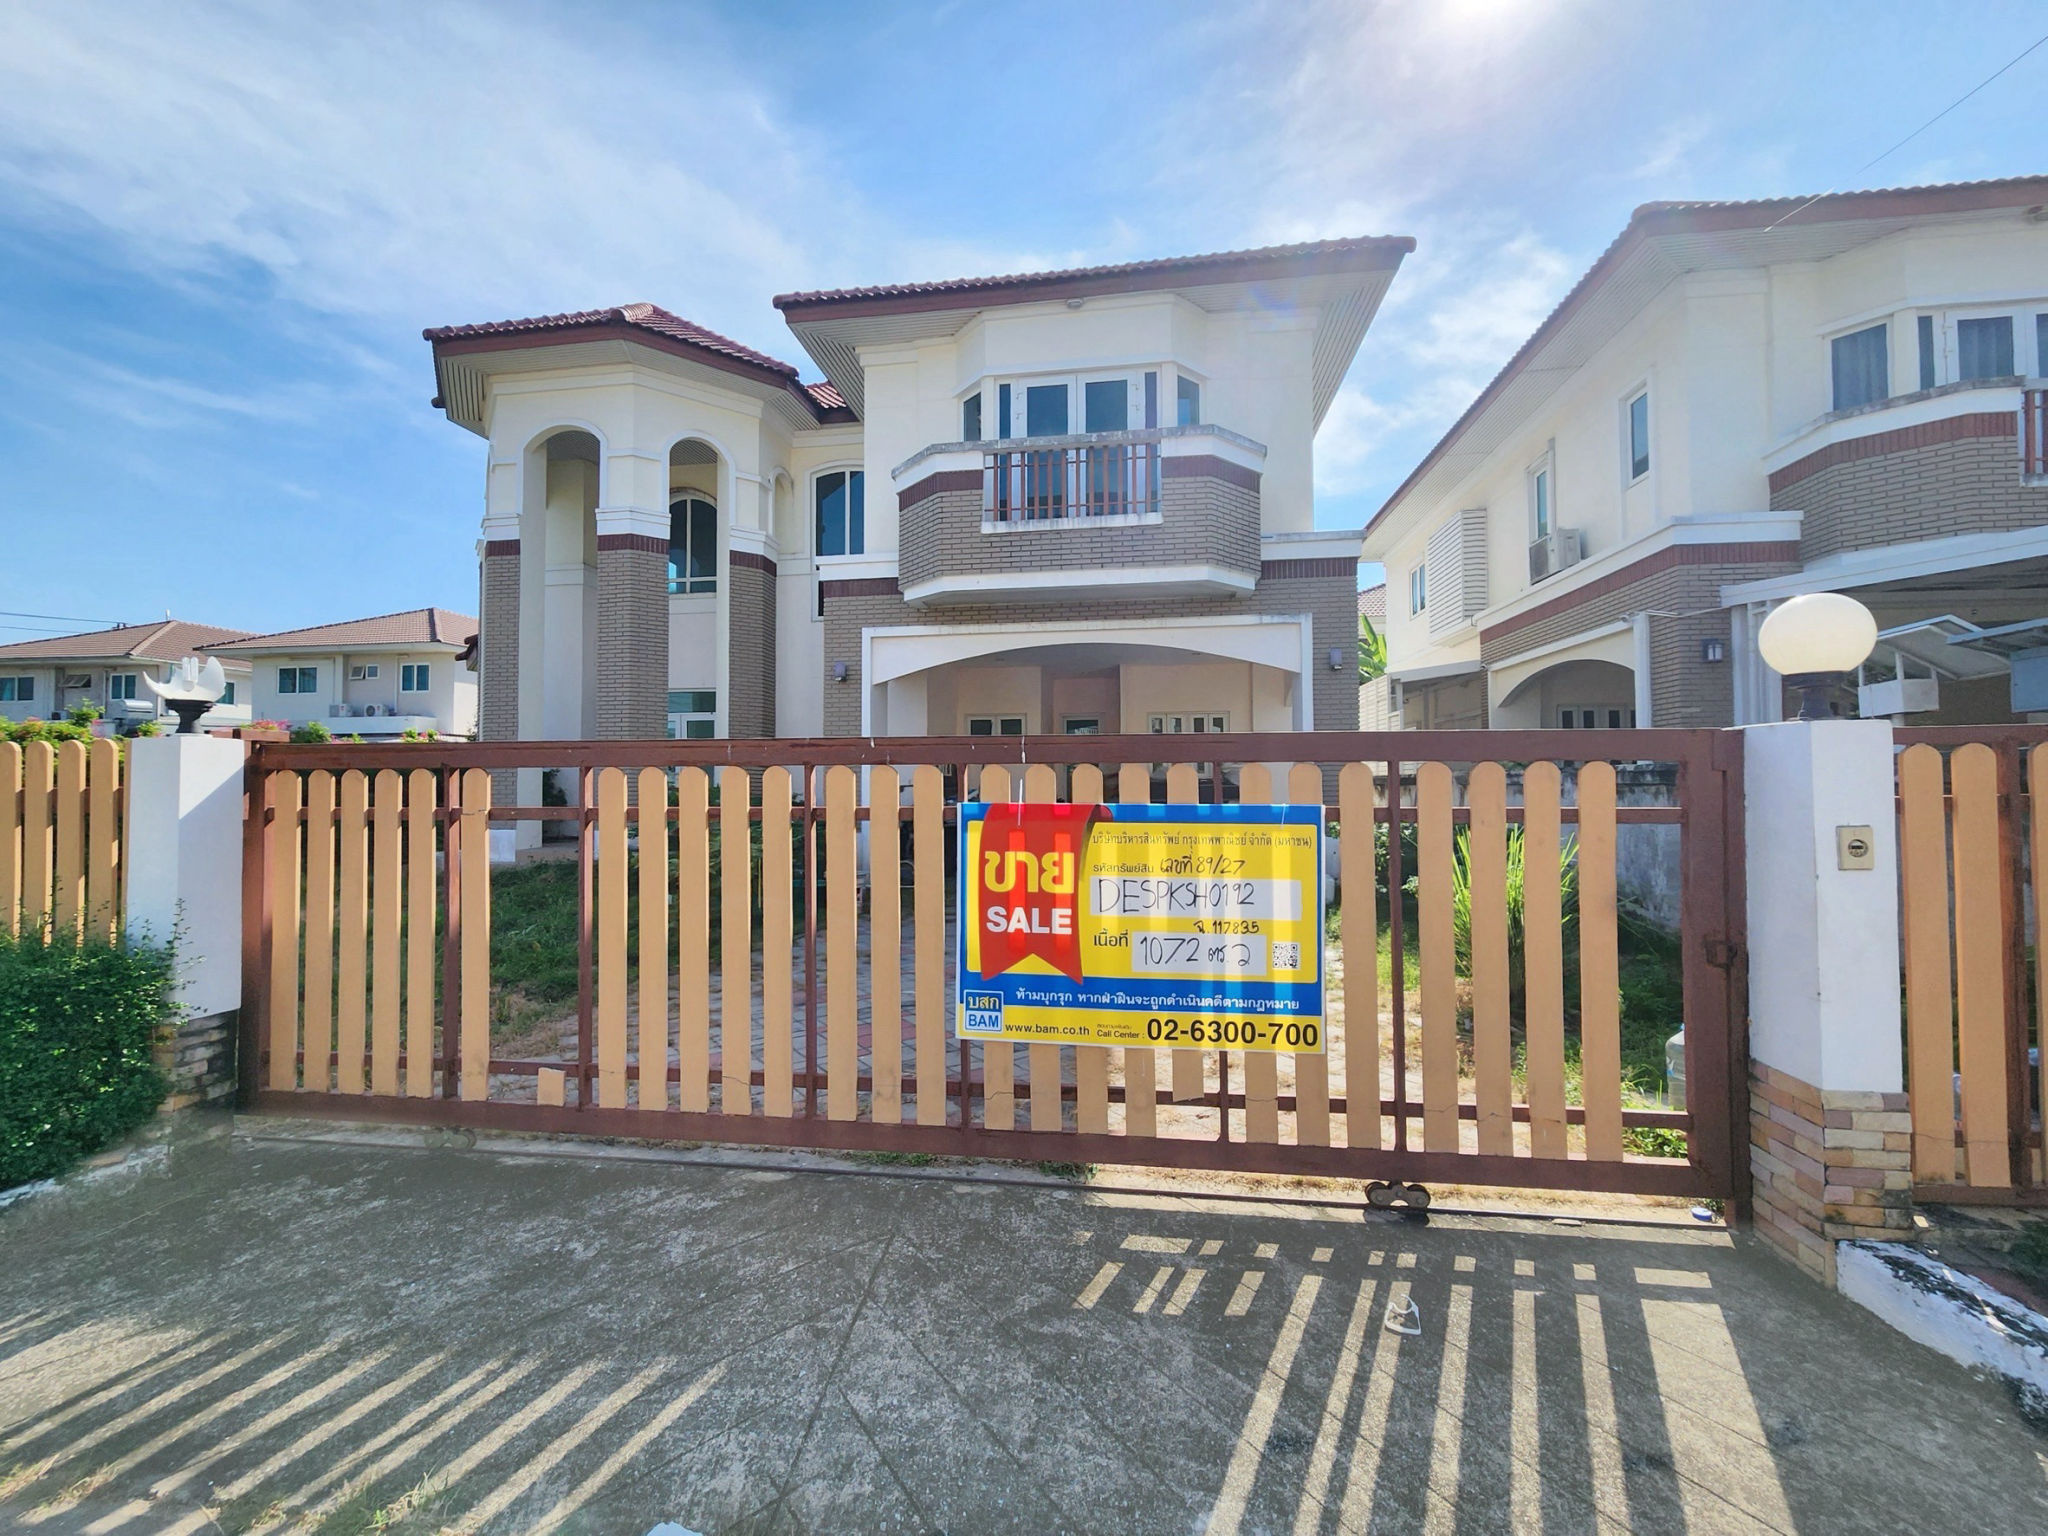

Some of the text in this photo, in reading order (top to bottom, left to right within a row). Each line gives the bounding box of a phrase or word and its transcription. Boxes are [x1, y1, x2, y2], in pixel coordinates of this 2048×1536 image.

[985, 851, 1074, 894] ขาย
[1196, 854, 1246, 875] 89/27
[986, 906, 1072, 934] SALE
[1093, 928, 1129, 947] เนื้อที่
[968, 996, 999, 1010] บสก
[1015, 987, 1073, 1005] ห้ามบุกรุก
[968, 1014, 999, 1029] BAM
[1005, 1023, 1090, 1036] www.bam.co.th
[1147, 1018, 1318, 1047] 02-6300-700
